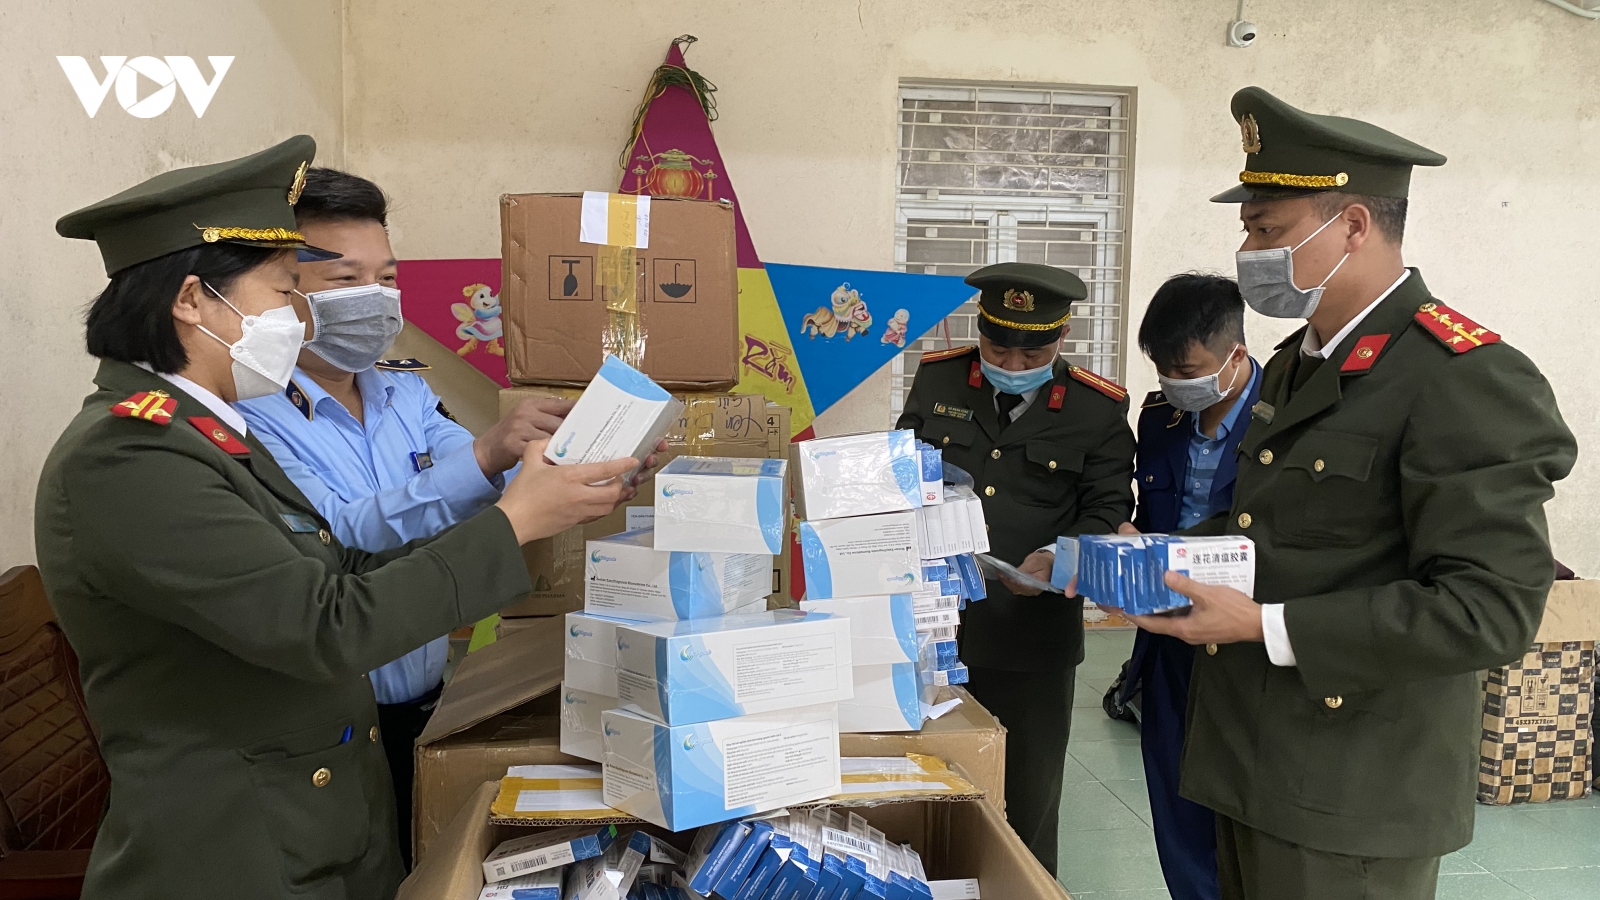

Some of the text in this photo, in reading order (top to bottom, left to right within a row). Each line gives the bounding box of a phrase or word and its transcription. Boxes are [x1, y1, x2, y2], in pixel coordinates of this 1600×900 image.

[1192, 551, 1249, 565] 连花清瘟胶囊
